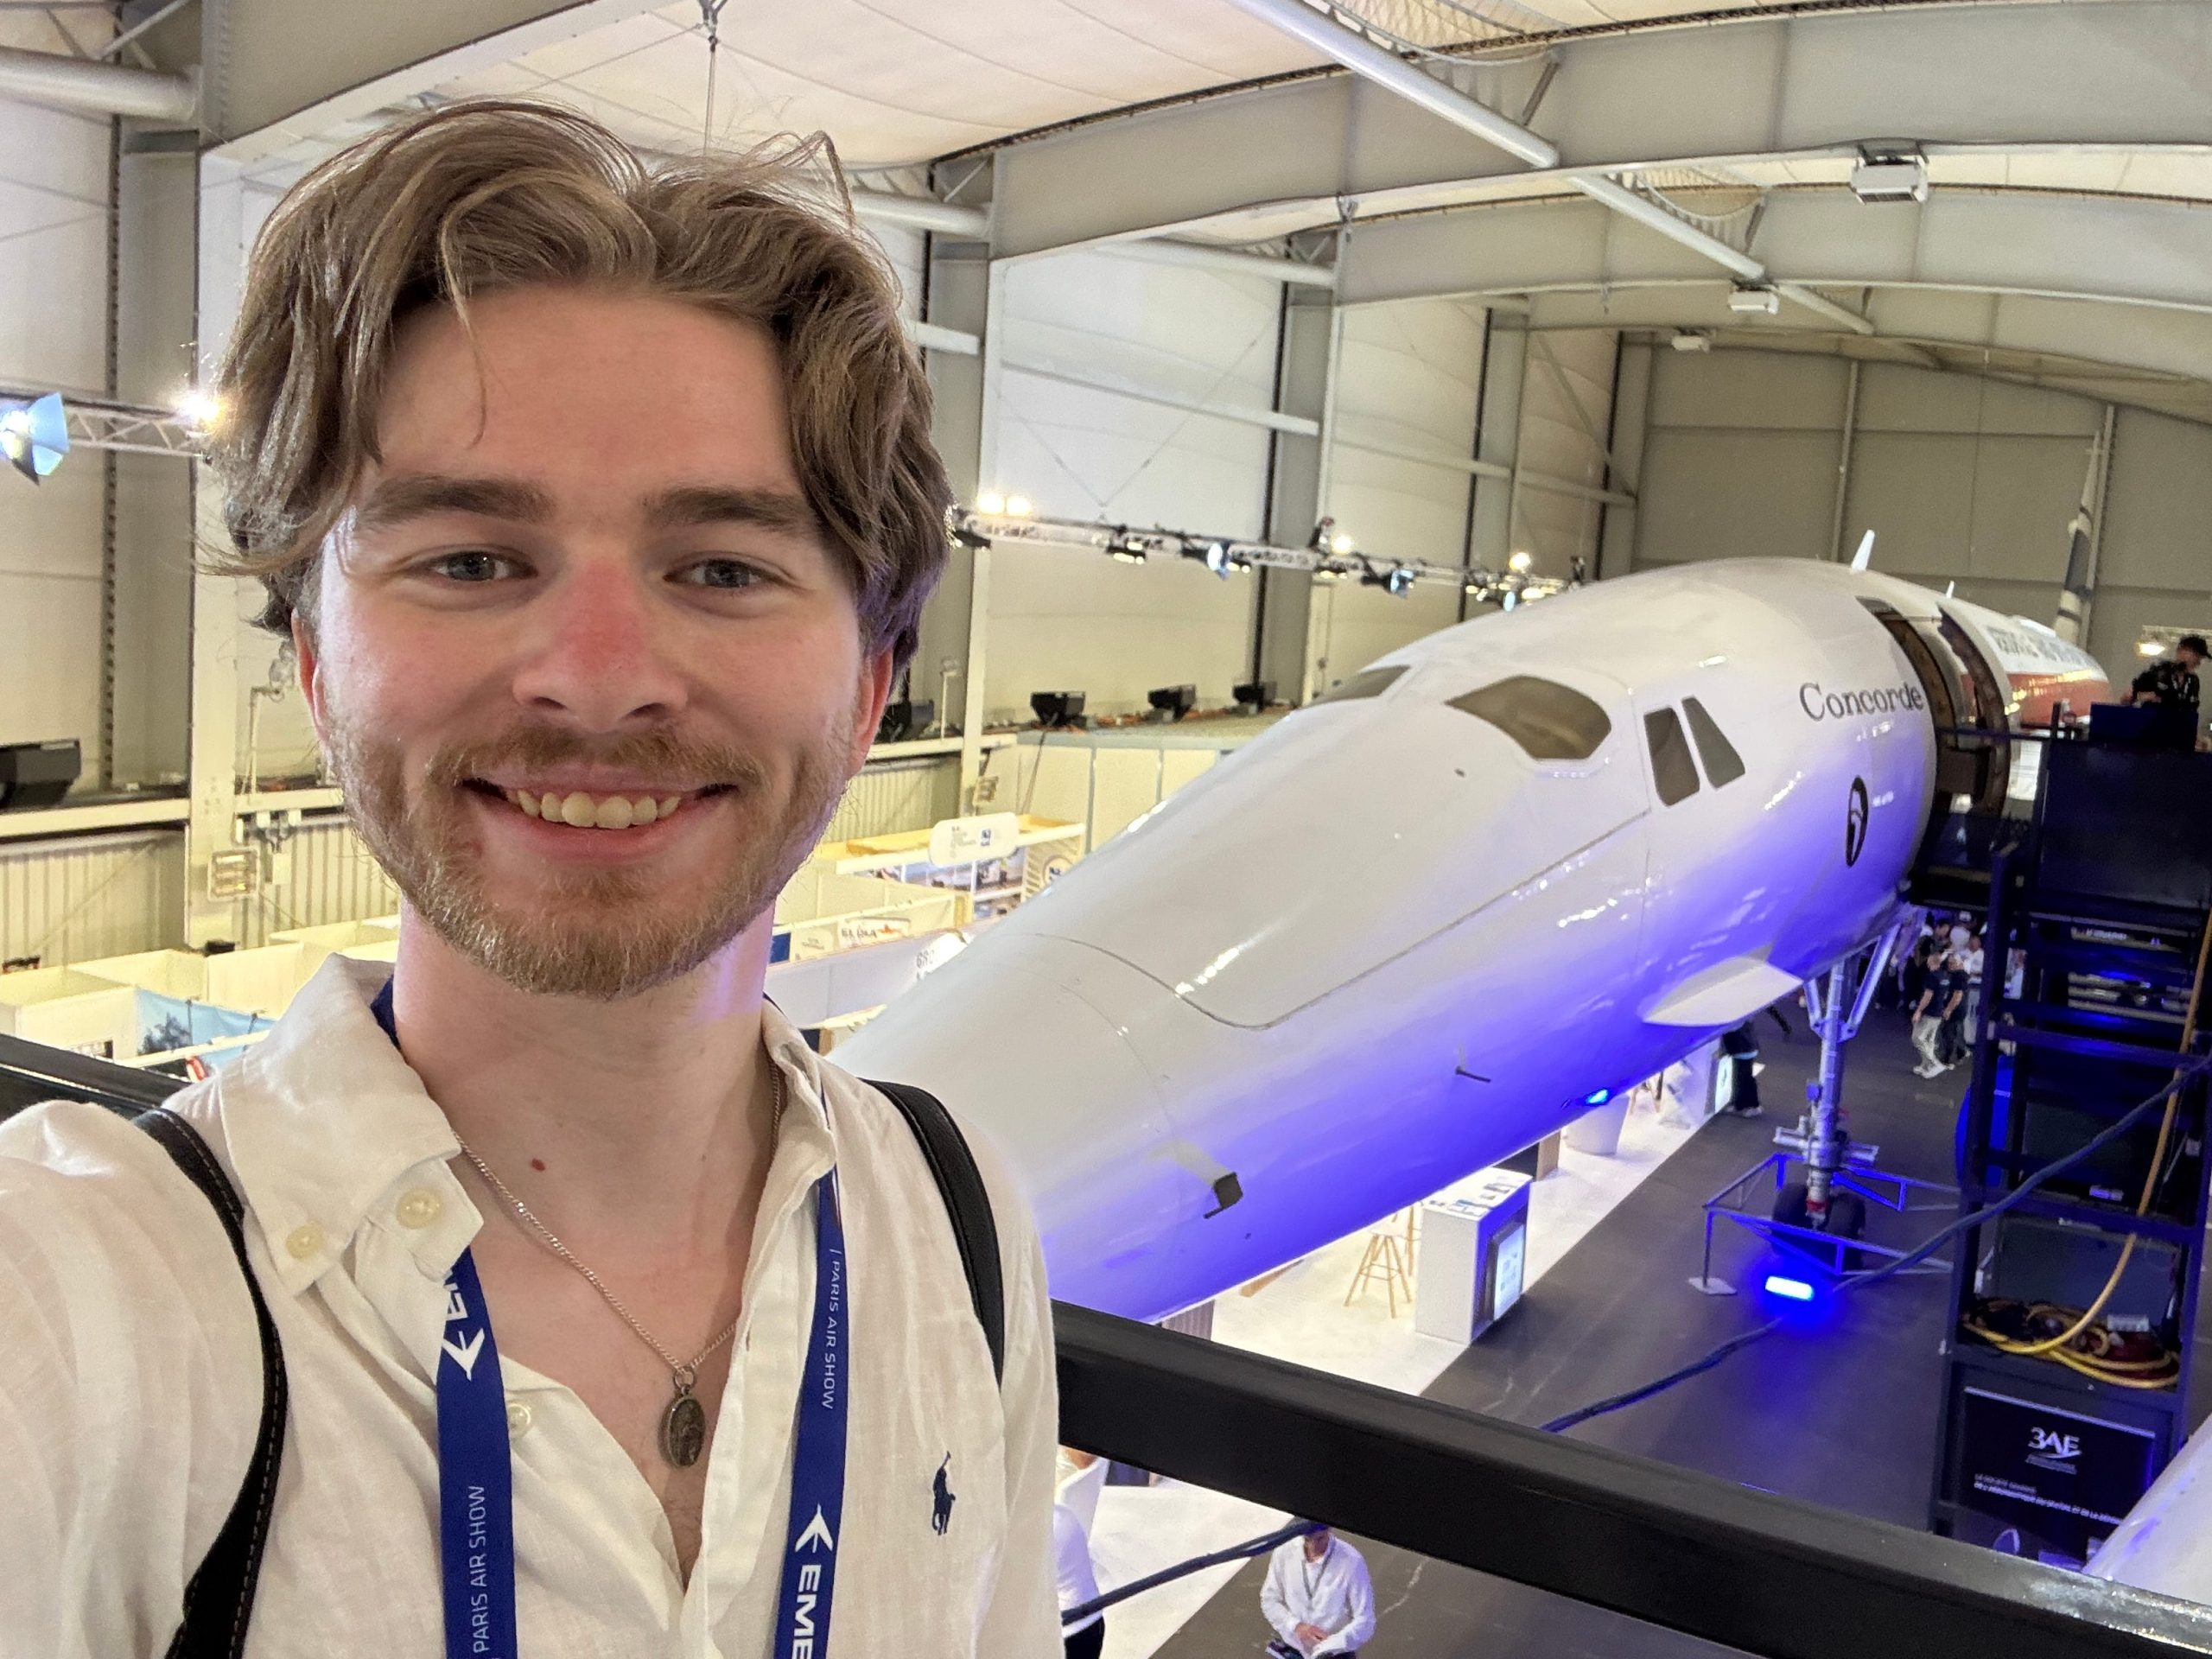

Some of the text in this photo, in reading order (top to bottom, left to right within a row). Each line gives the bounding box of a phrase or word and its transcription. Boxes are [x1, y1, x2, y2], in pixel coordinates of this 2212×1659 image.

[1799, 682, 1923, 721] Concorde
[822, 1260, 841, 1409] PARIS AIR SHOW
[467, 1486, 490, 1653] PARIS AIR SHOW
